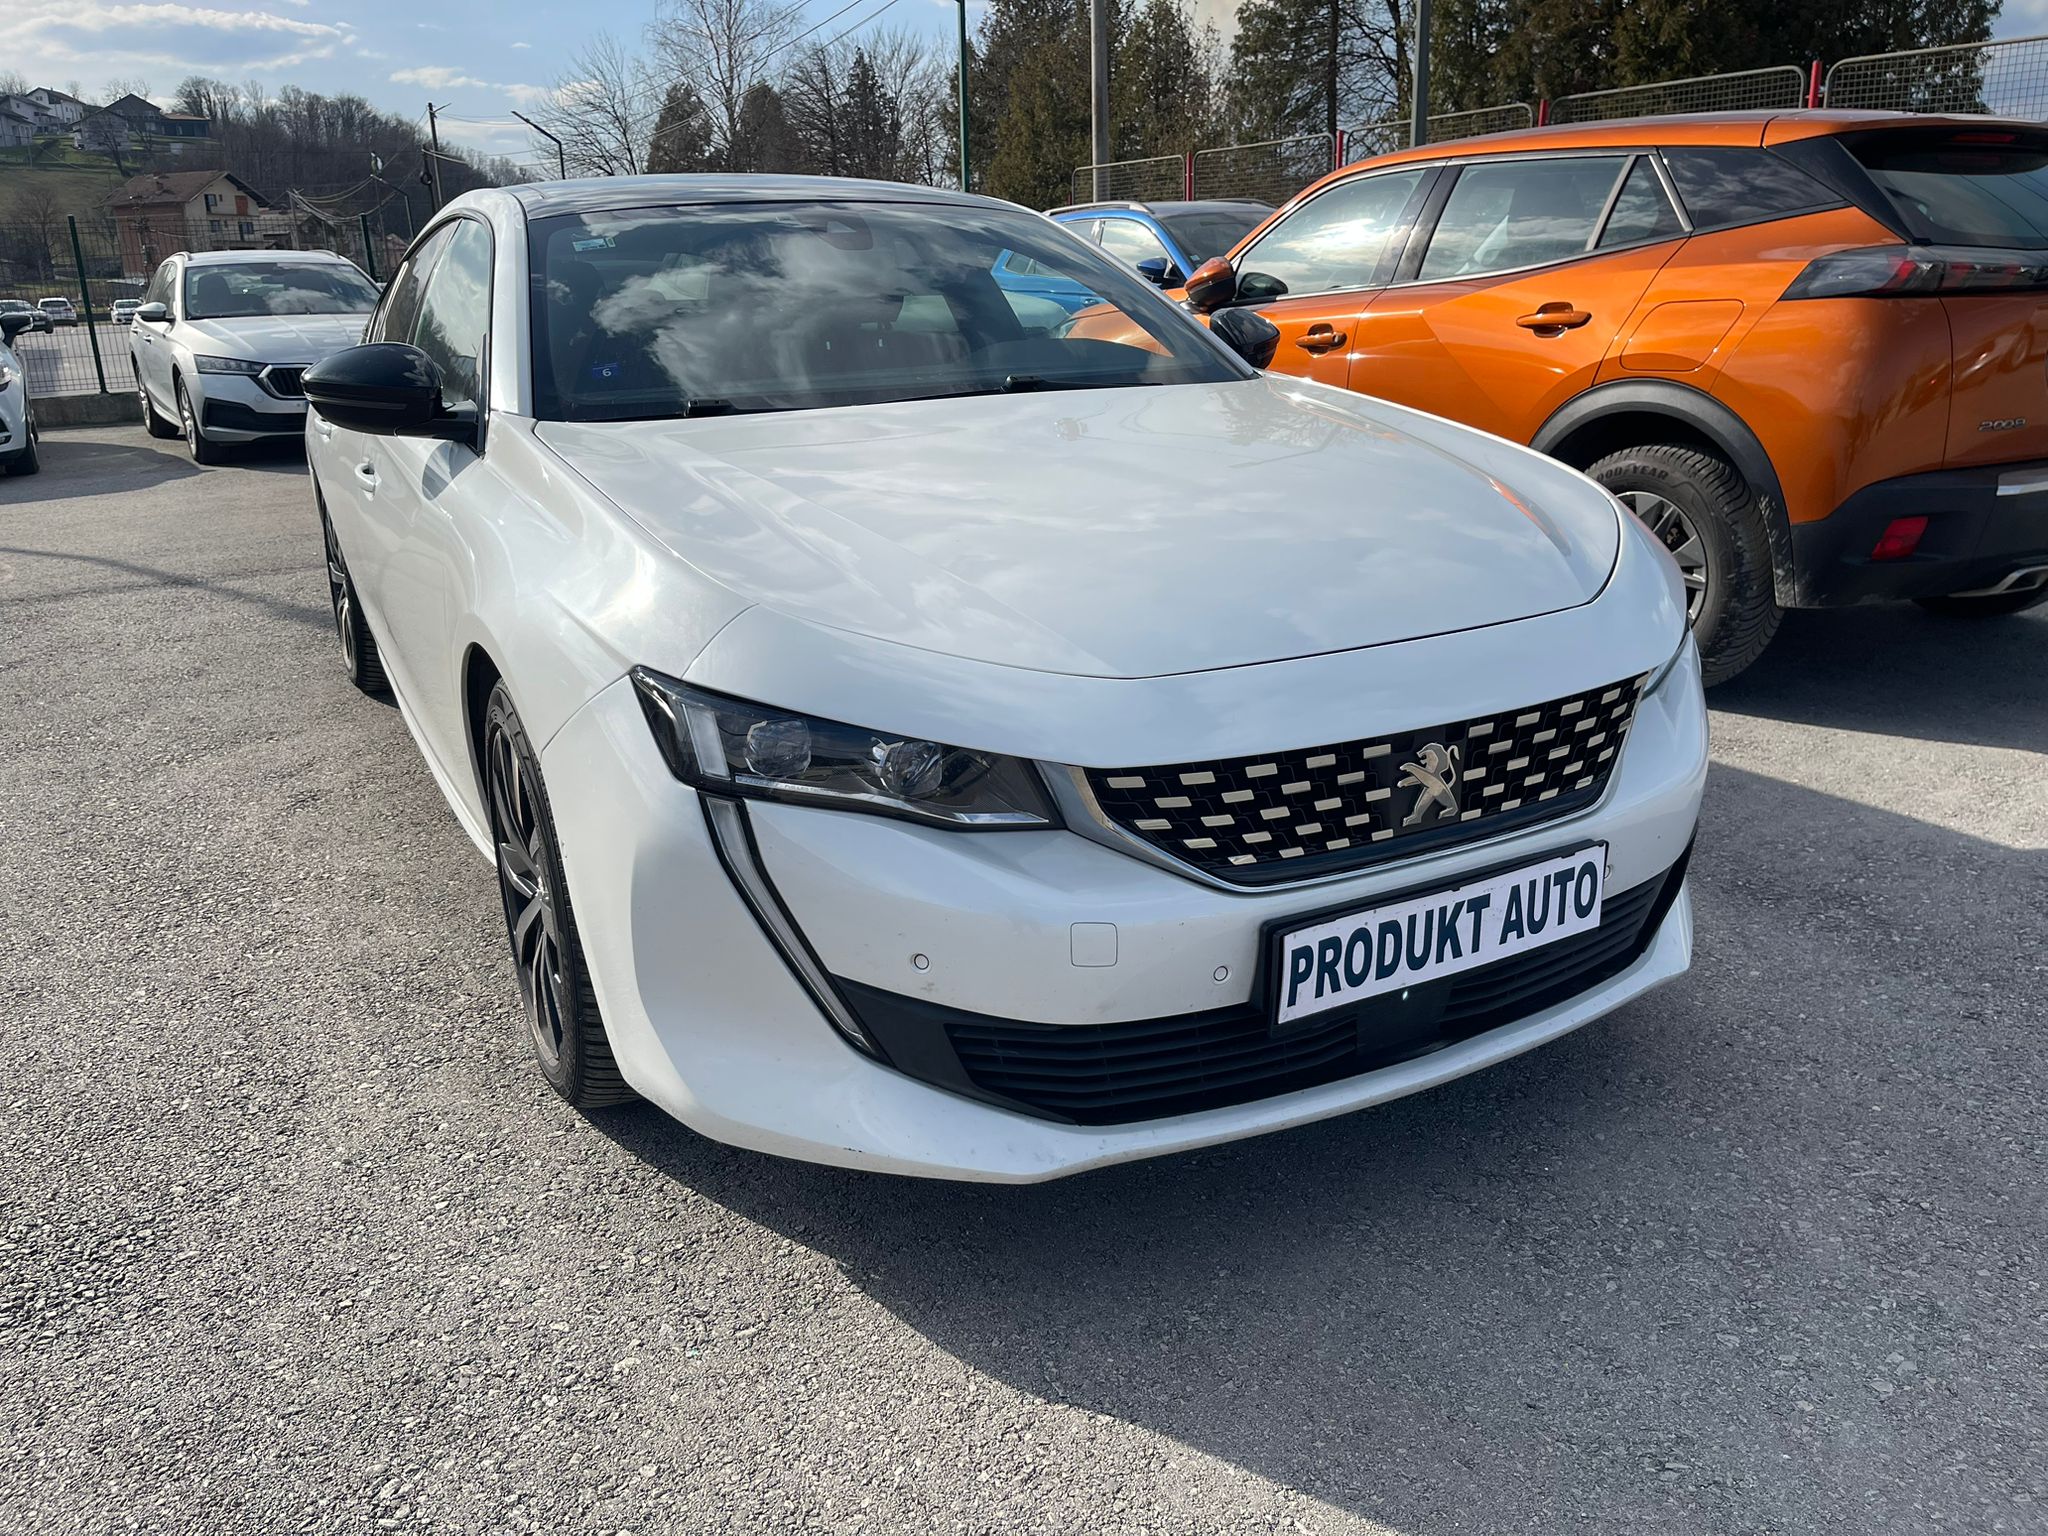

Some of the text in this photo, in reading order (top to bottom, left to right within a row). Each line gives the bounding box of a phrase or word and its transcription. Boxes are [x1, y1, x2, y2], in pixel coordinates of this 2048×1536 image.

[602, 368, 612, 377] 6
[1287, 861, 1598, 1008] PRODUKT AUTO
